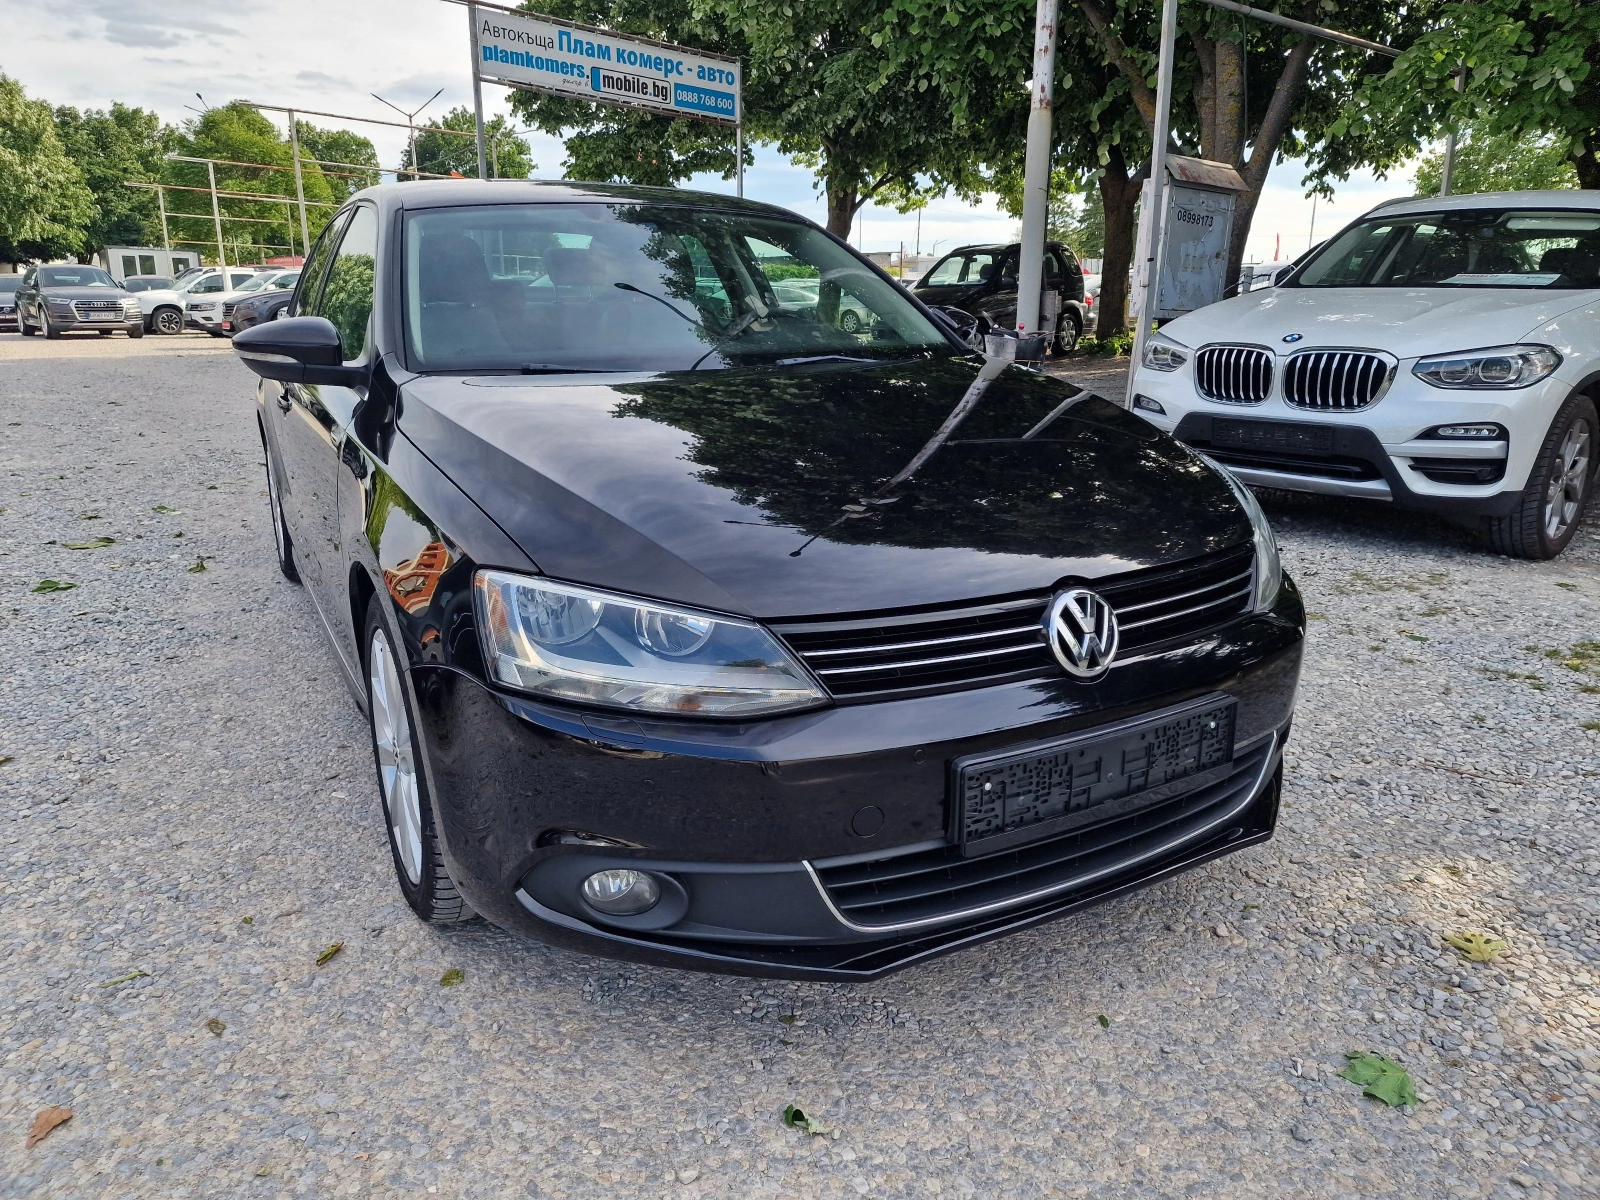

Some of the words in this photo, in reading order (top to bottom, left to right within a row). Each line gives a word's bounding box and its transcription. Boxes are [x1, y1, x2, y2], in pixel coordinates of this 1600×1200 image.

[482, 19, 554, 51] Автокъща
[558, 29, 611, 62] Плам
[616, 47, 683, 78] комерс
[696, 64, 735, 86] авто
[602, 73, 668, 101] mobile.bg
[676, 89, 698, 104] 0888
[700, 93, 715, 107] 768
[717, 97, 733, 110] 600
[1177, 210, 1214, 227] 08998173
